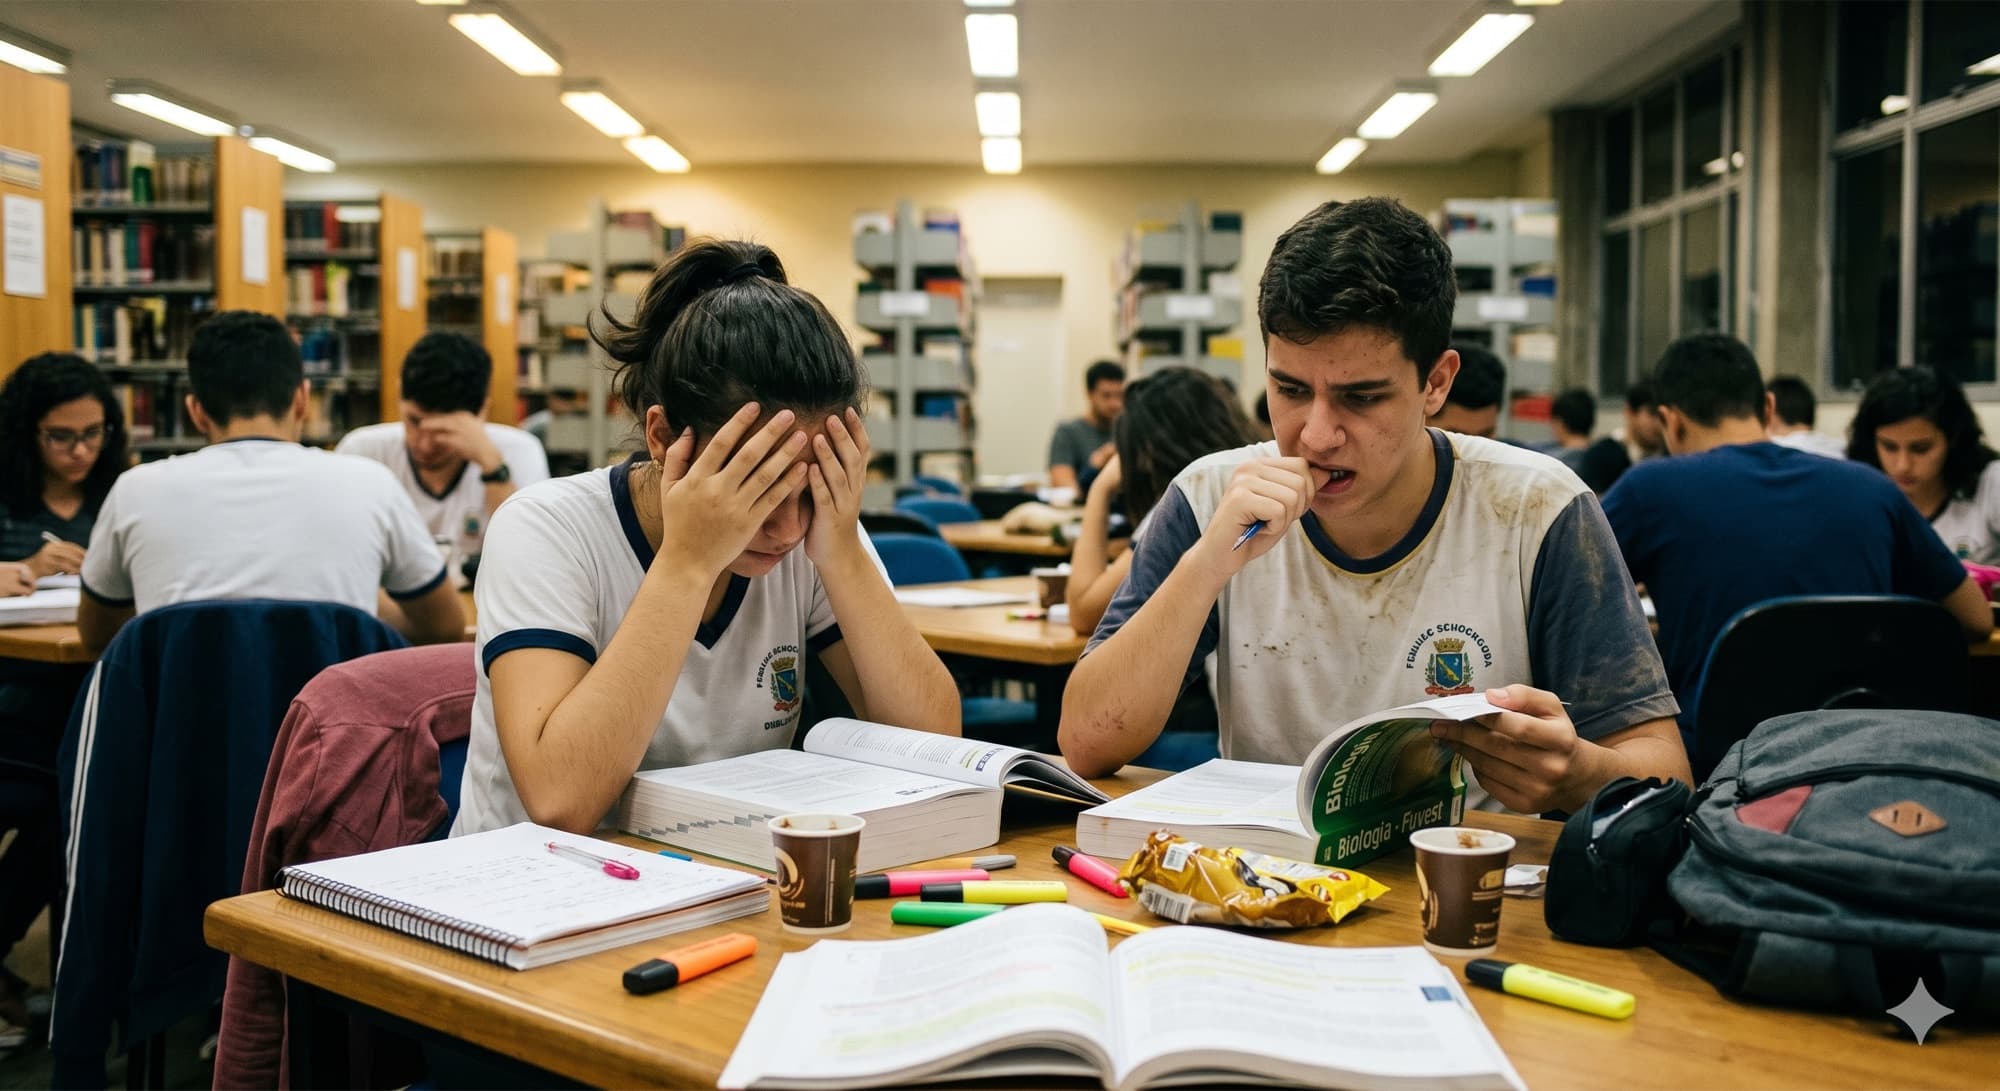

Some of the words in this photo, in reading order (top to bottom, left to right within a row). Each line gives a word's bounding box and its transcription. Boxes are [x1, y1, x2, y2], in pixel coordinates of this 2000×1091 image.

[1325, 731, 1383, 815] Biologia
[1337, 821, 1391, 860] Biologia
[1401, 800, 1444, 834] Fuvest
